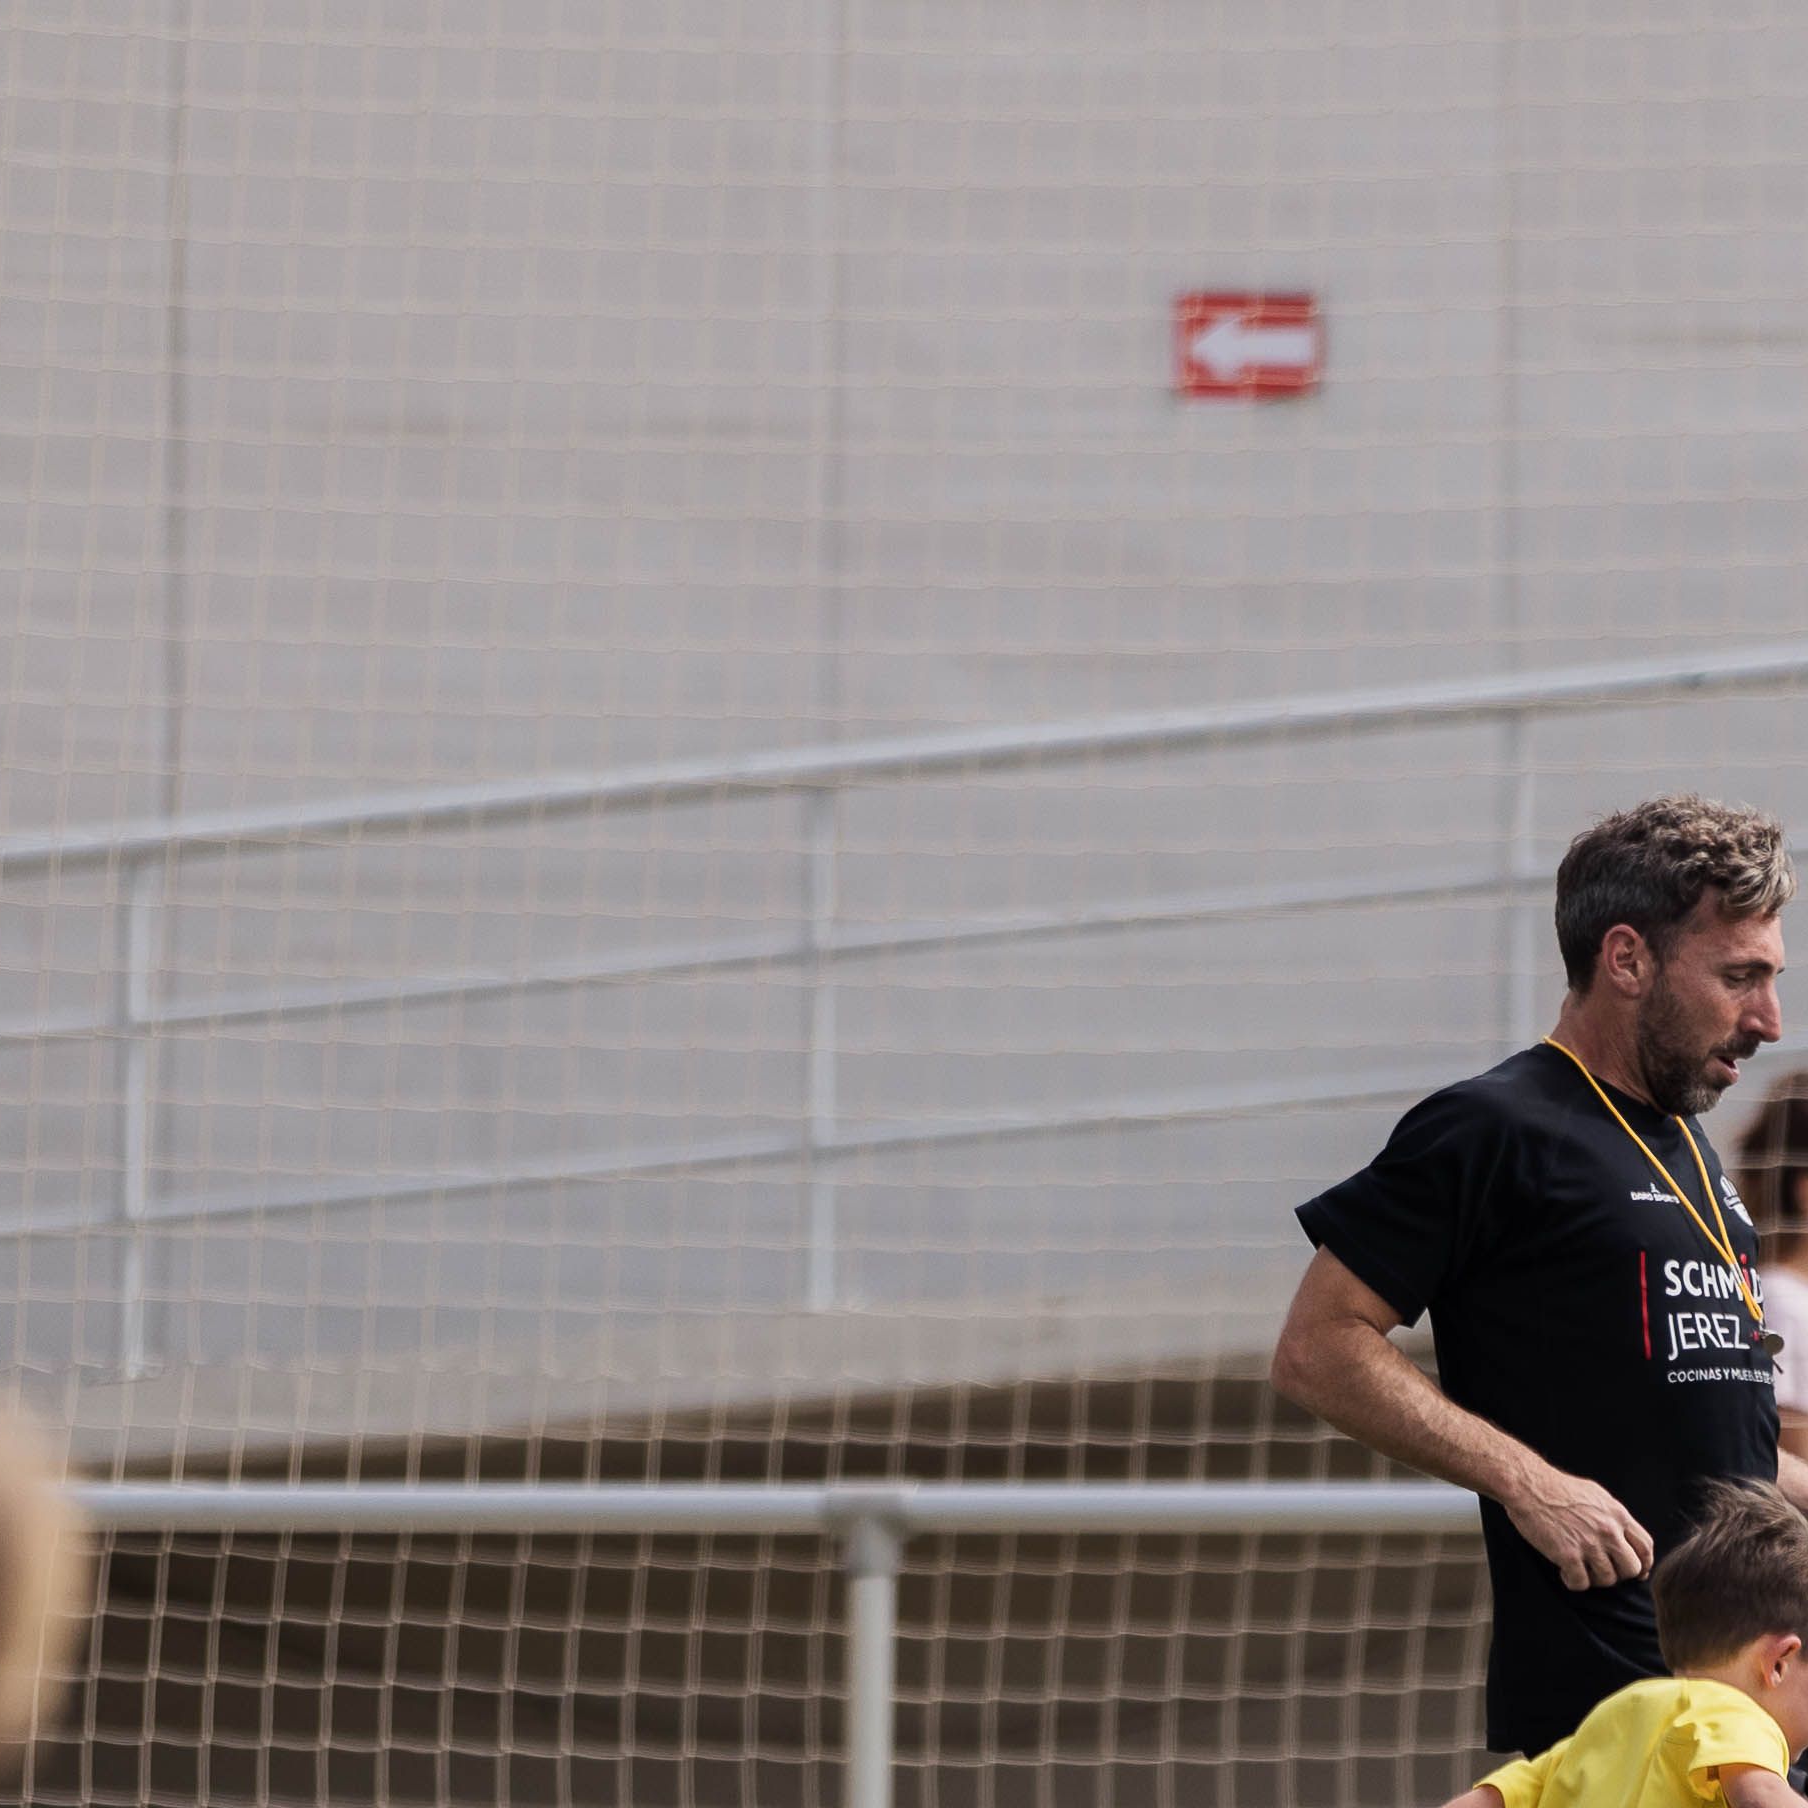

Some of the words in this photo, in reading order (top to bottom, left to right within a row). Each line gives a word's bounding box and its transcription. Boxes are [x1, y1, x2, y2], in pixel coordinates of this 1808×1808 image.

[1667, 1312, 1751, 1361] JEREZ
[1667, 1367, 1722, 1383] COCINAS
[1722, 1368, 1730, 1381] Y
